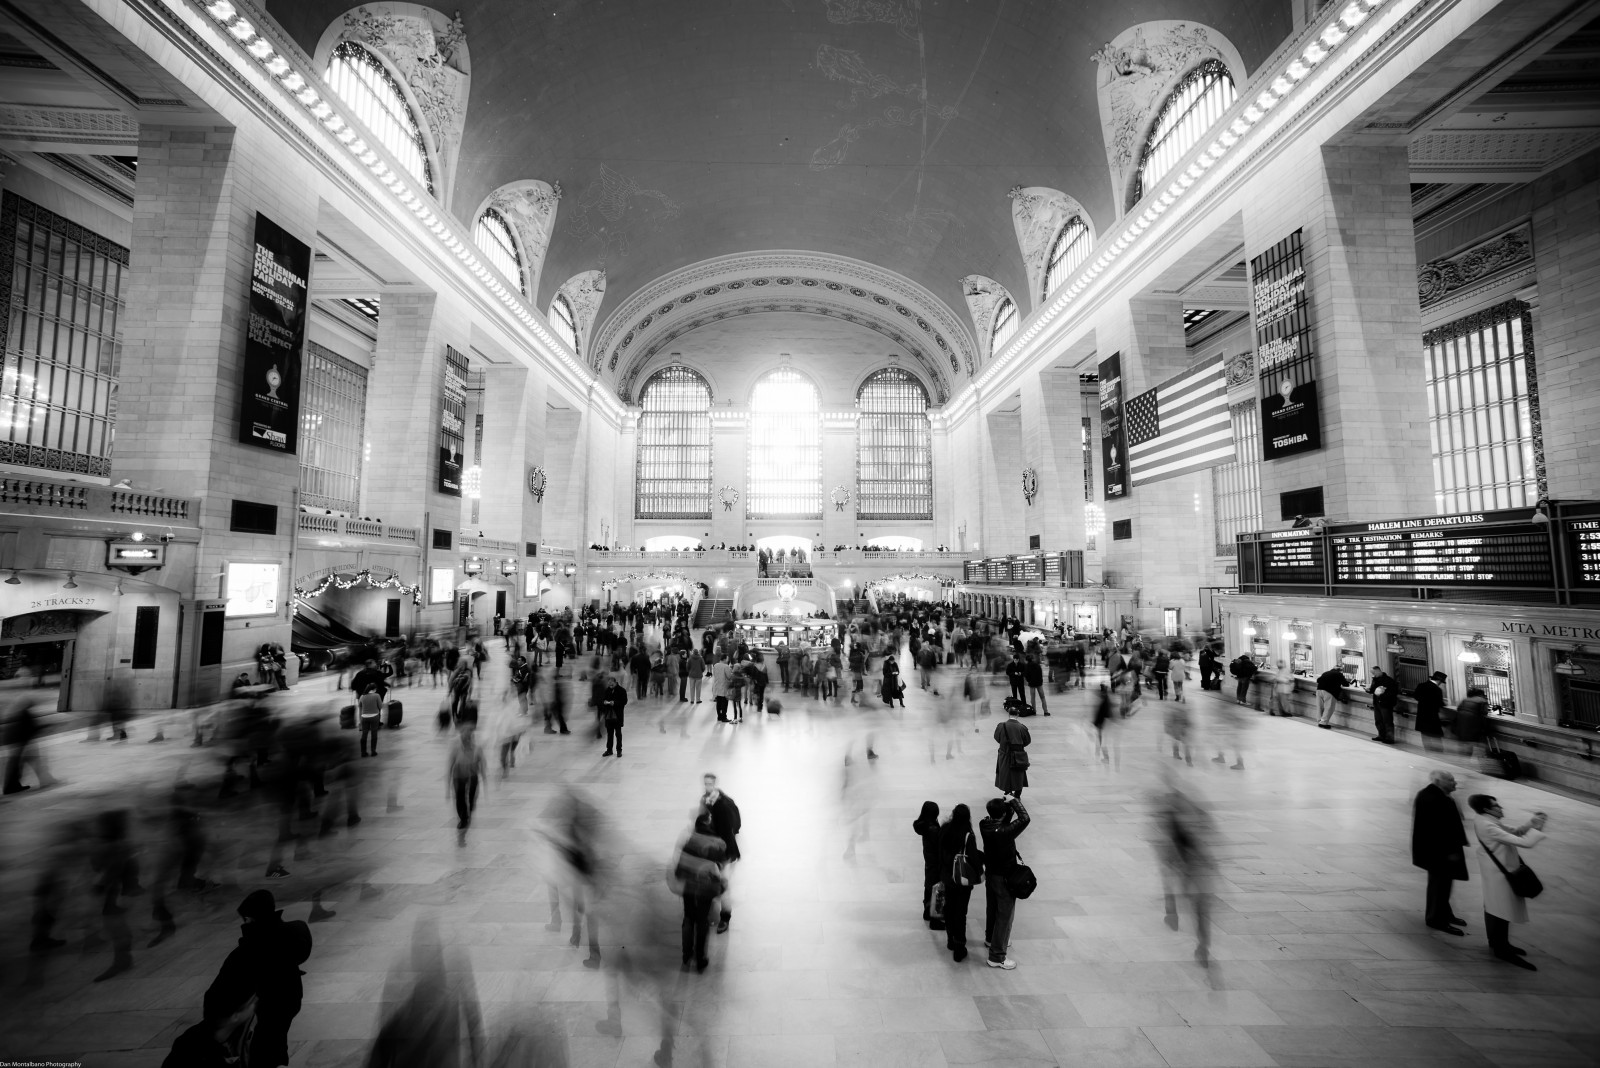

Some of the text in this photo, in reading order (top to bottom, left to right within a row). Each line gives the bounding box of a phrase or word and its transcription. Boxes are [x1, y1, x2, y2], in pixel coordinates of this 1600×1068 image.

[256, 243, 274, 260] THE
[254, 268, 274, 287] FAIR
[255, 252, 306, 289] CENTENNIAL
[255, 260, 294, 288] HOLIDAY
[1254, 279, 1269, 292] THE
[1255, 267, 1304, 300] CENTENNIAL
[1256, 282, 1290, 308] HOLIDAY
[1256, 281, 1305, 315] LIGHT SHOW
[266, 320, 293, 338] PERFECT
[264, 333, 292, 350] PERFECT
[1259, 336, 1299, 358] TERMINAL IN
[1270, 337, 1282, 347] THE
[1265, 343, 1297, 362] DAZZLING
[1273, 433, 1308, 448] TOSHIBA
[1368, 515, 1484, 531] HARLEM LINE DEPARTURES
[1272, 530, 1310, 538] INFORMATION
[44, 598, 84, 606] TRACKS
[1501, 622, 1536, 634] MTA
